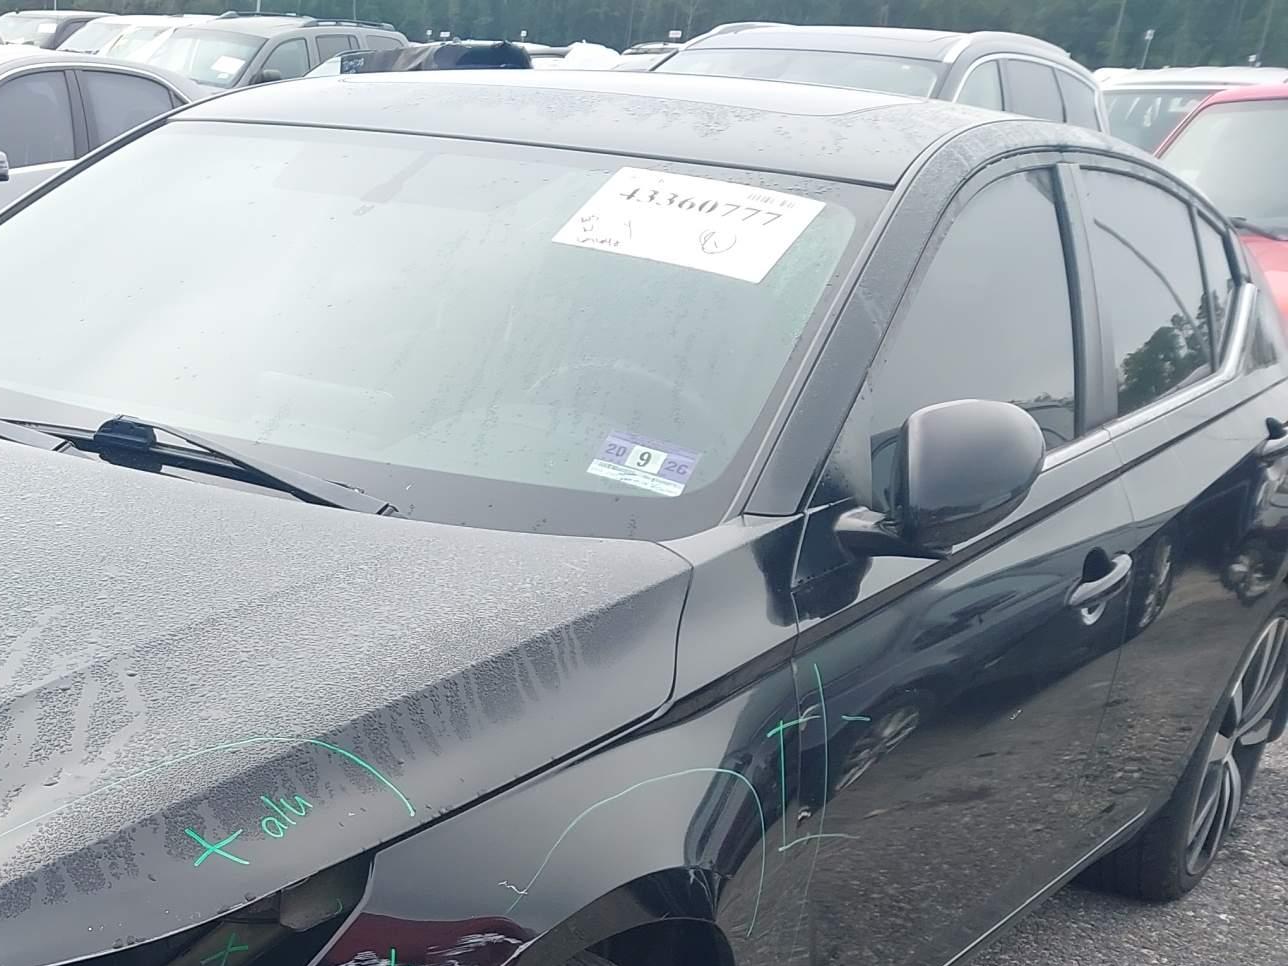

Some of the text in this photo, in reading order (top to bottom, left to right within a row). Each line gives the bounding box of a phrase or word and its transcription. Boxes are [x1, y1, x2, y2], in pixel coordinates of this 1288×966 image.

[618, 186, 784, 227] 43360777
[605, 442, 689, 476] 20 9 26
